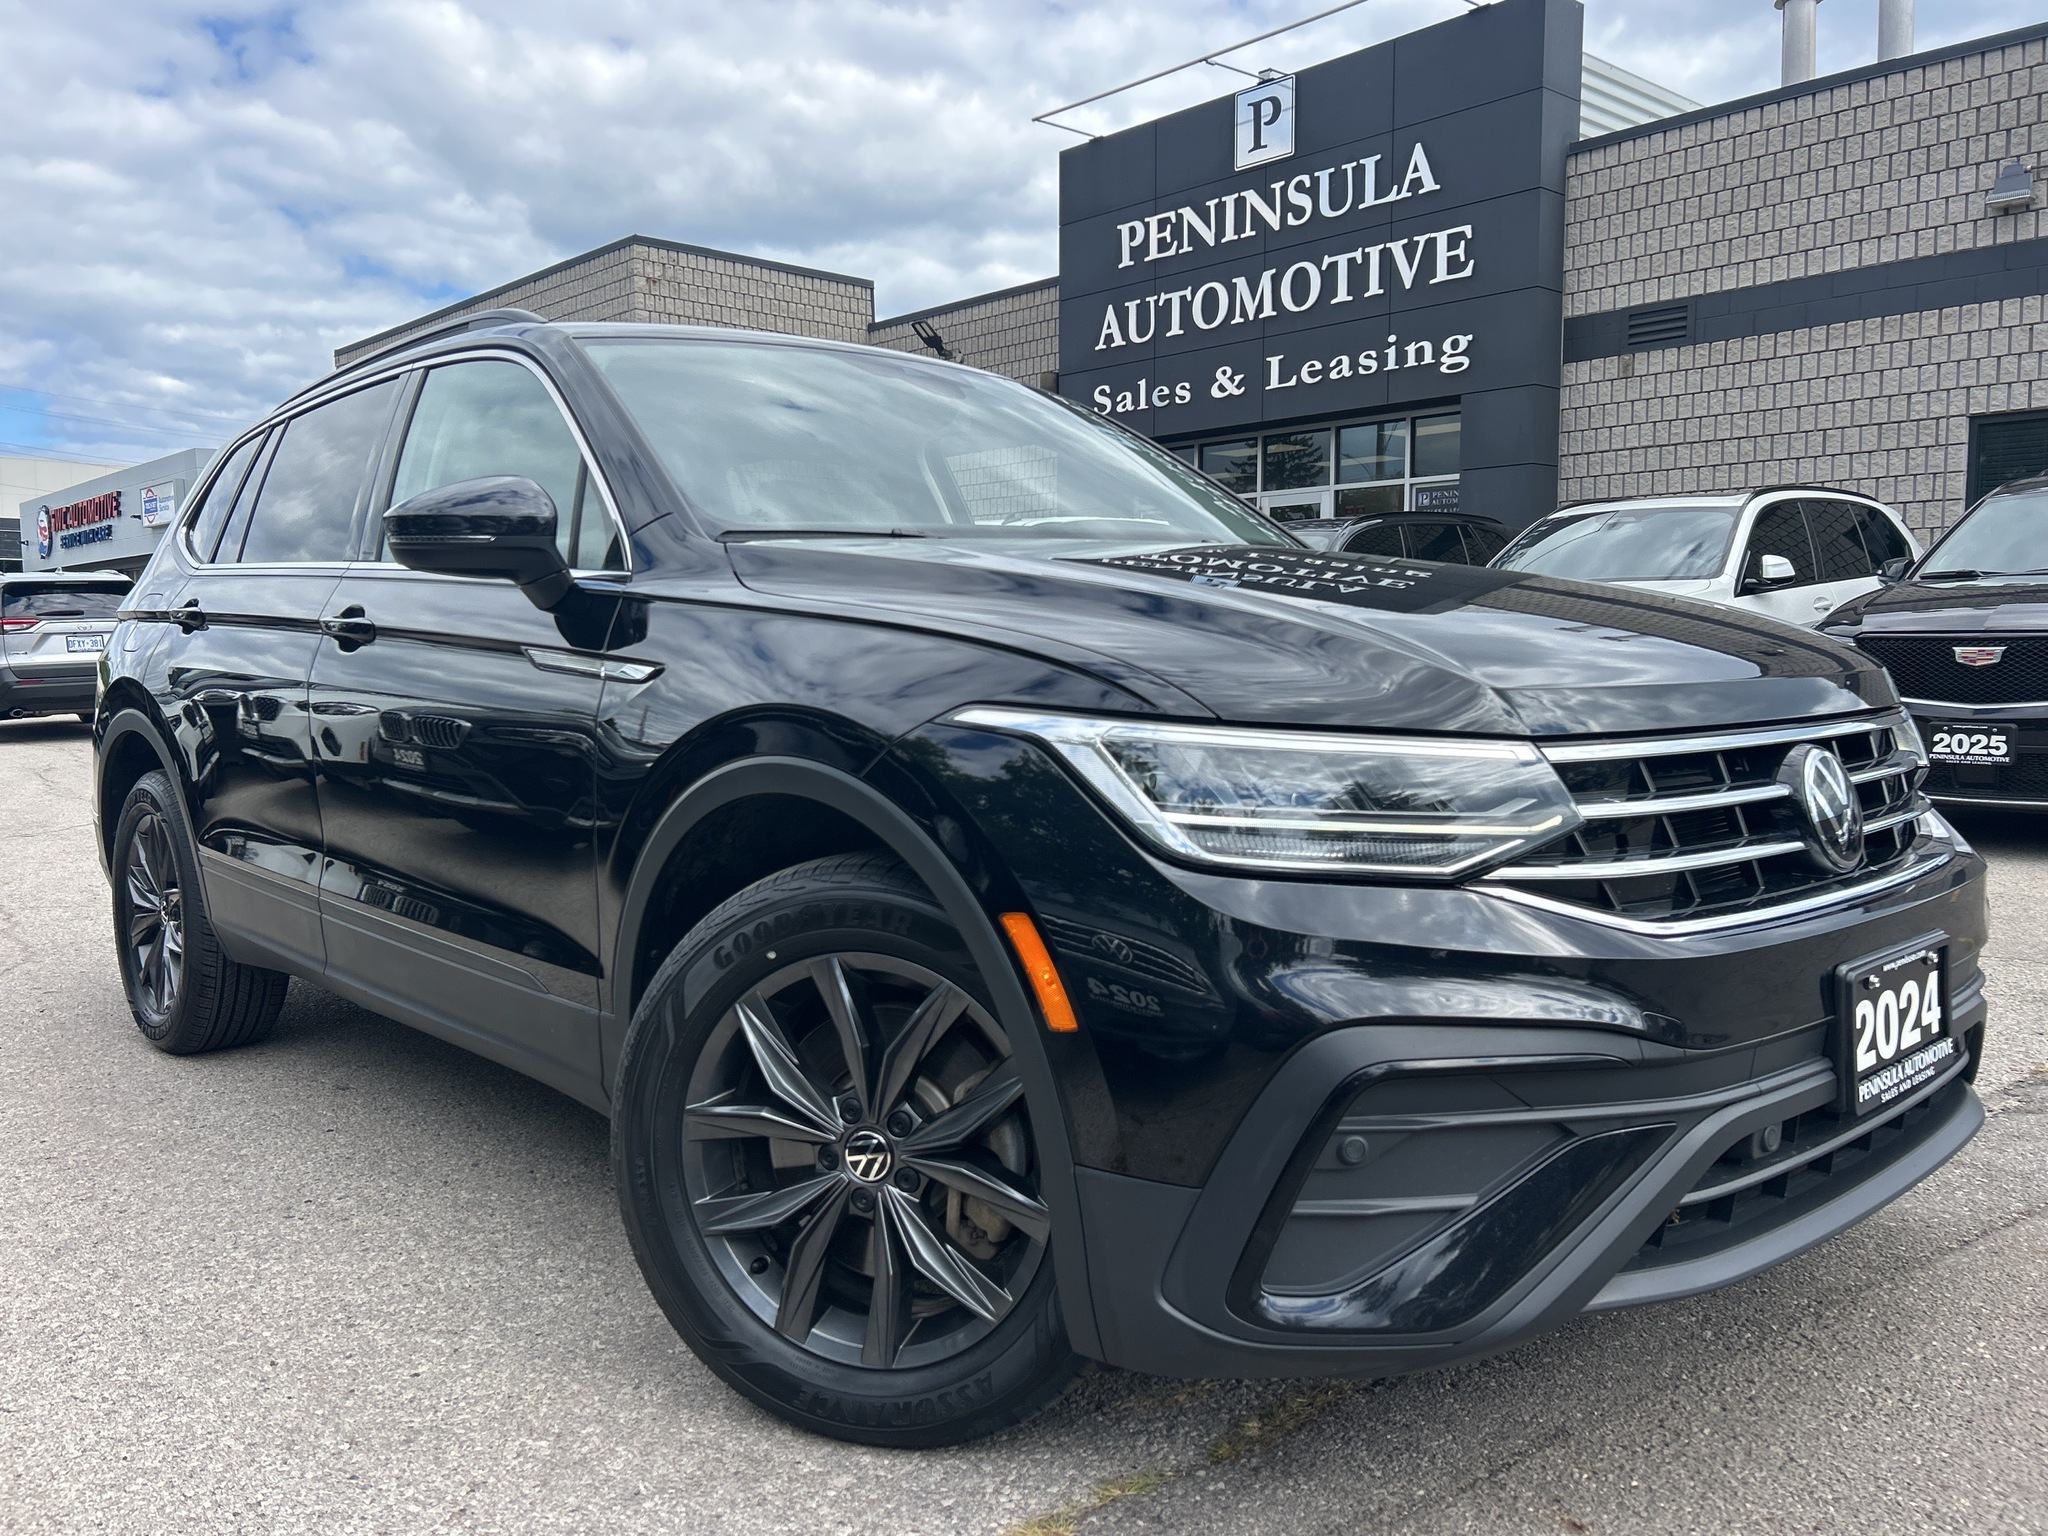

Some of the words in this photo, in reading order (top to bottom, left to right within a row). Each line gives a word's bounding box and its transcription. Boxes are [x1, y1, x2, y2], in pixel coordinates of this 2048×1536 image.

[1246, 95, 1282, 155] P
[1116, 142, 1441, 269] PENINSULA
[1094, 224, 1475, 351] AUTOMOTIVE
[1092, 379, 1192, 416] Sales
[1210, 364, 1246, 399] &
[1264, 332, 1474, 391] Leasing
[68, 491, 120, 528] AUTOMOTIVE
[1929, 753, 1965, 761] PENINSULA
[1966, 755, 2010, 763] AUTOMOTIVE
[1932, 732, 2008, 756] 2025
[1855, 970, 1942, 1073] 2024
[1858, 1065, 1904, 1103] PENINSULA
[1904, 1037, 1954, 1078] AUTOMOTIVE
[1881, 1086, 1899, 1103] SALES
[1899, 1079, 1912, 1093] AND
[1912, 1066, 1936, 1086] LEASING
